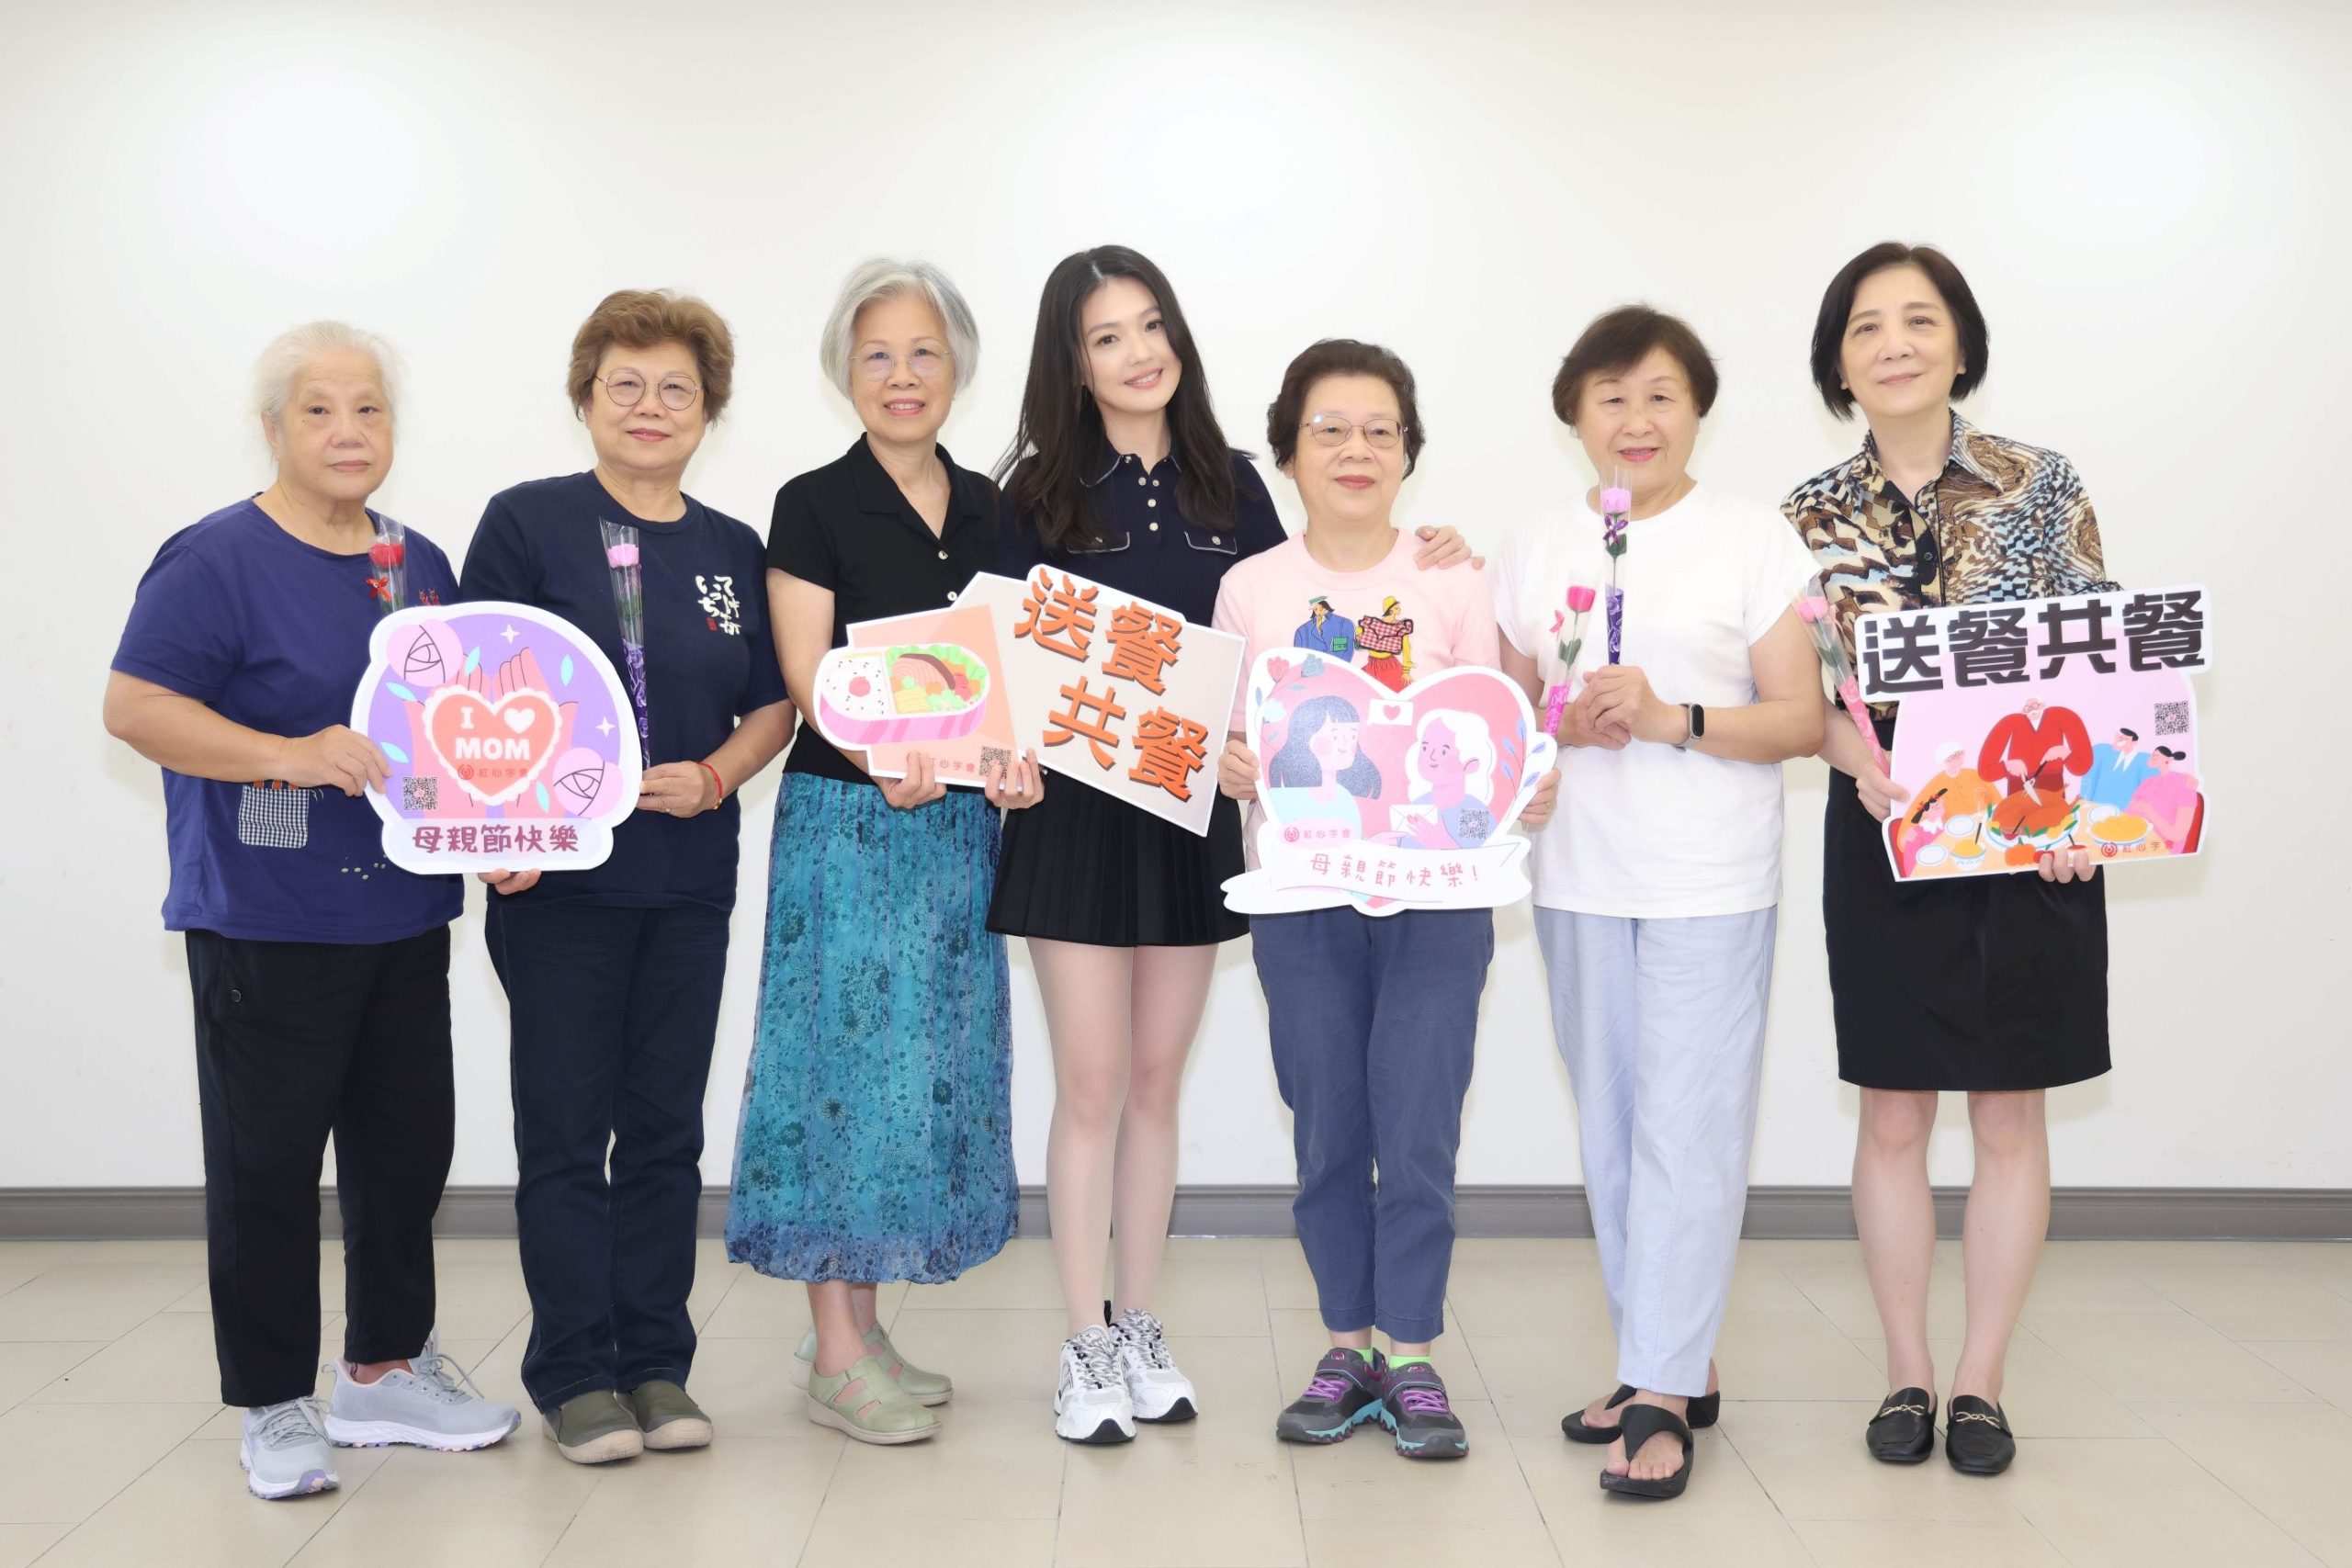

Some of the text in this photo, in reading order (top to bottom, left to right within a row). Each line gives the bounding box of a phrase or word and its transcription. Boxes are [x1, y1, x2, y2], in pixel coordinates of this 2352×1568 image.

[1014, 567, 1182, 695] 送餐
[1863, 590, 2205, 695] 送餐共餐
[455, 738, 530, 761] MOM
[461, 706, 474, 729] I
[1042, 675, 1209, 804] 共餐
[413, 824, 579, 853] 母親節快樂
